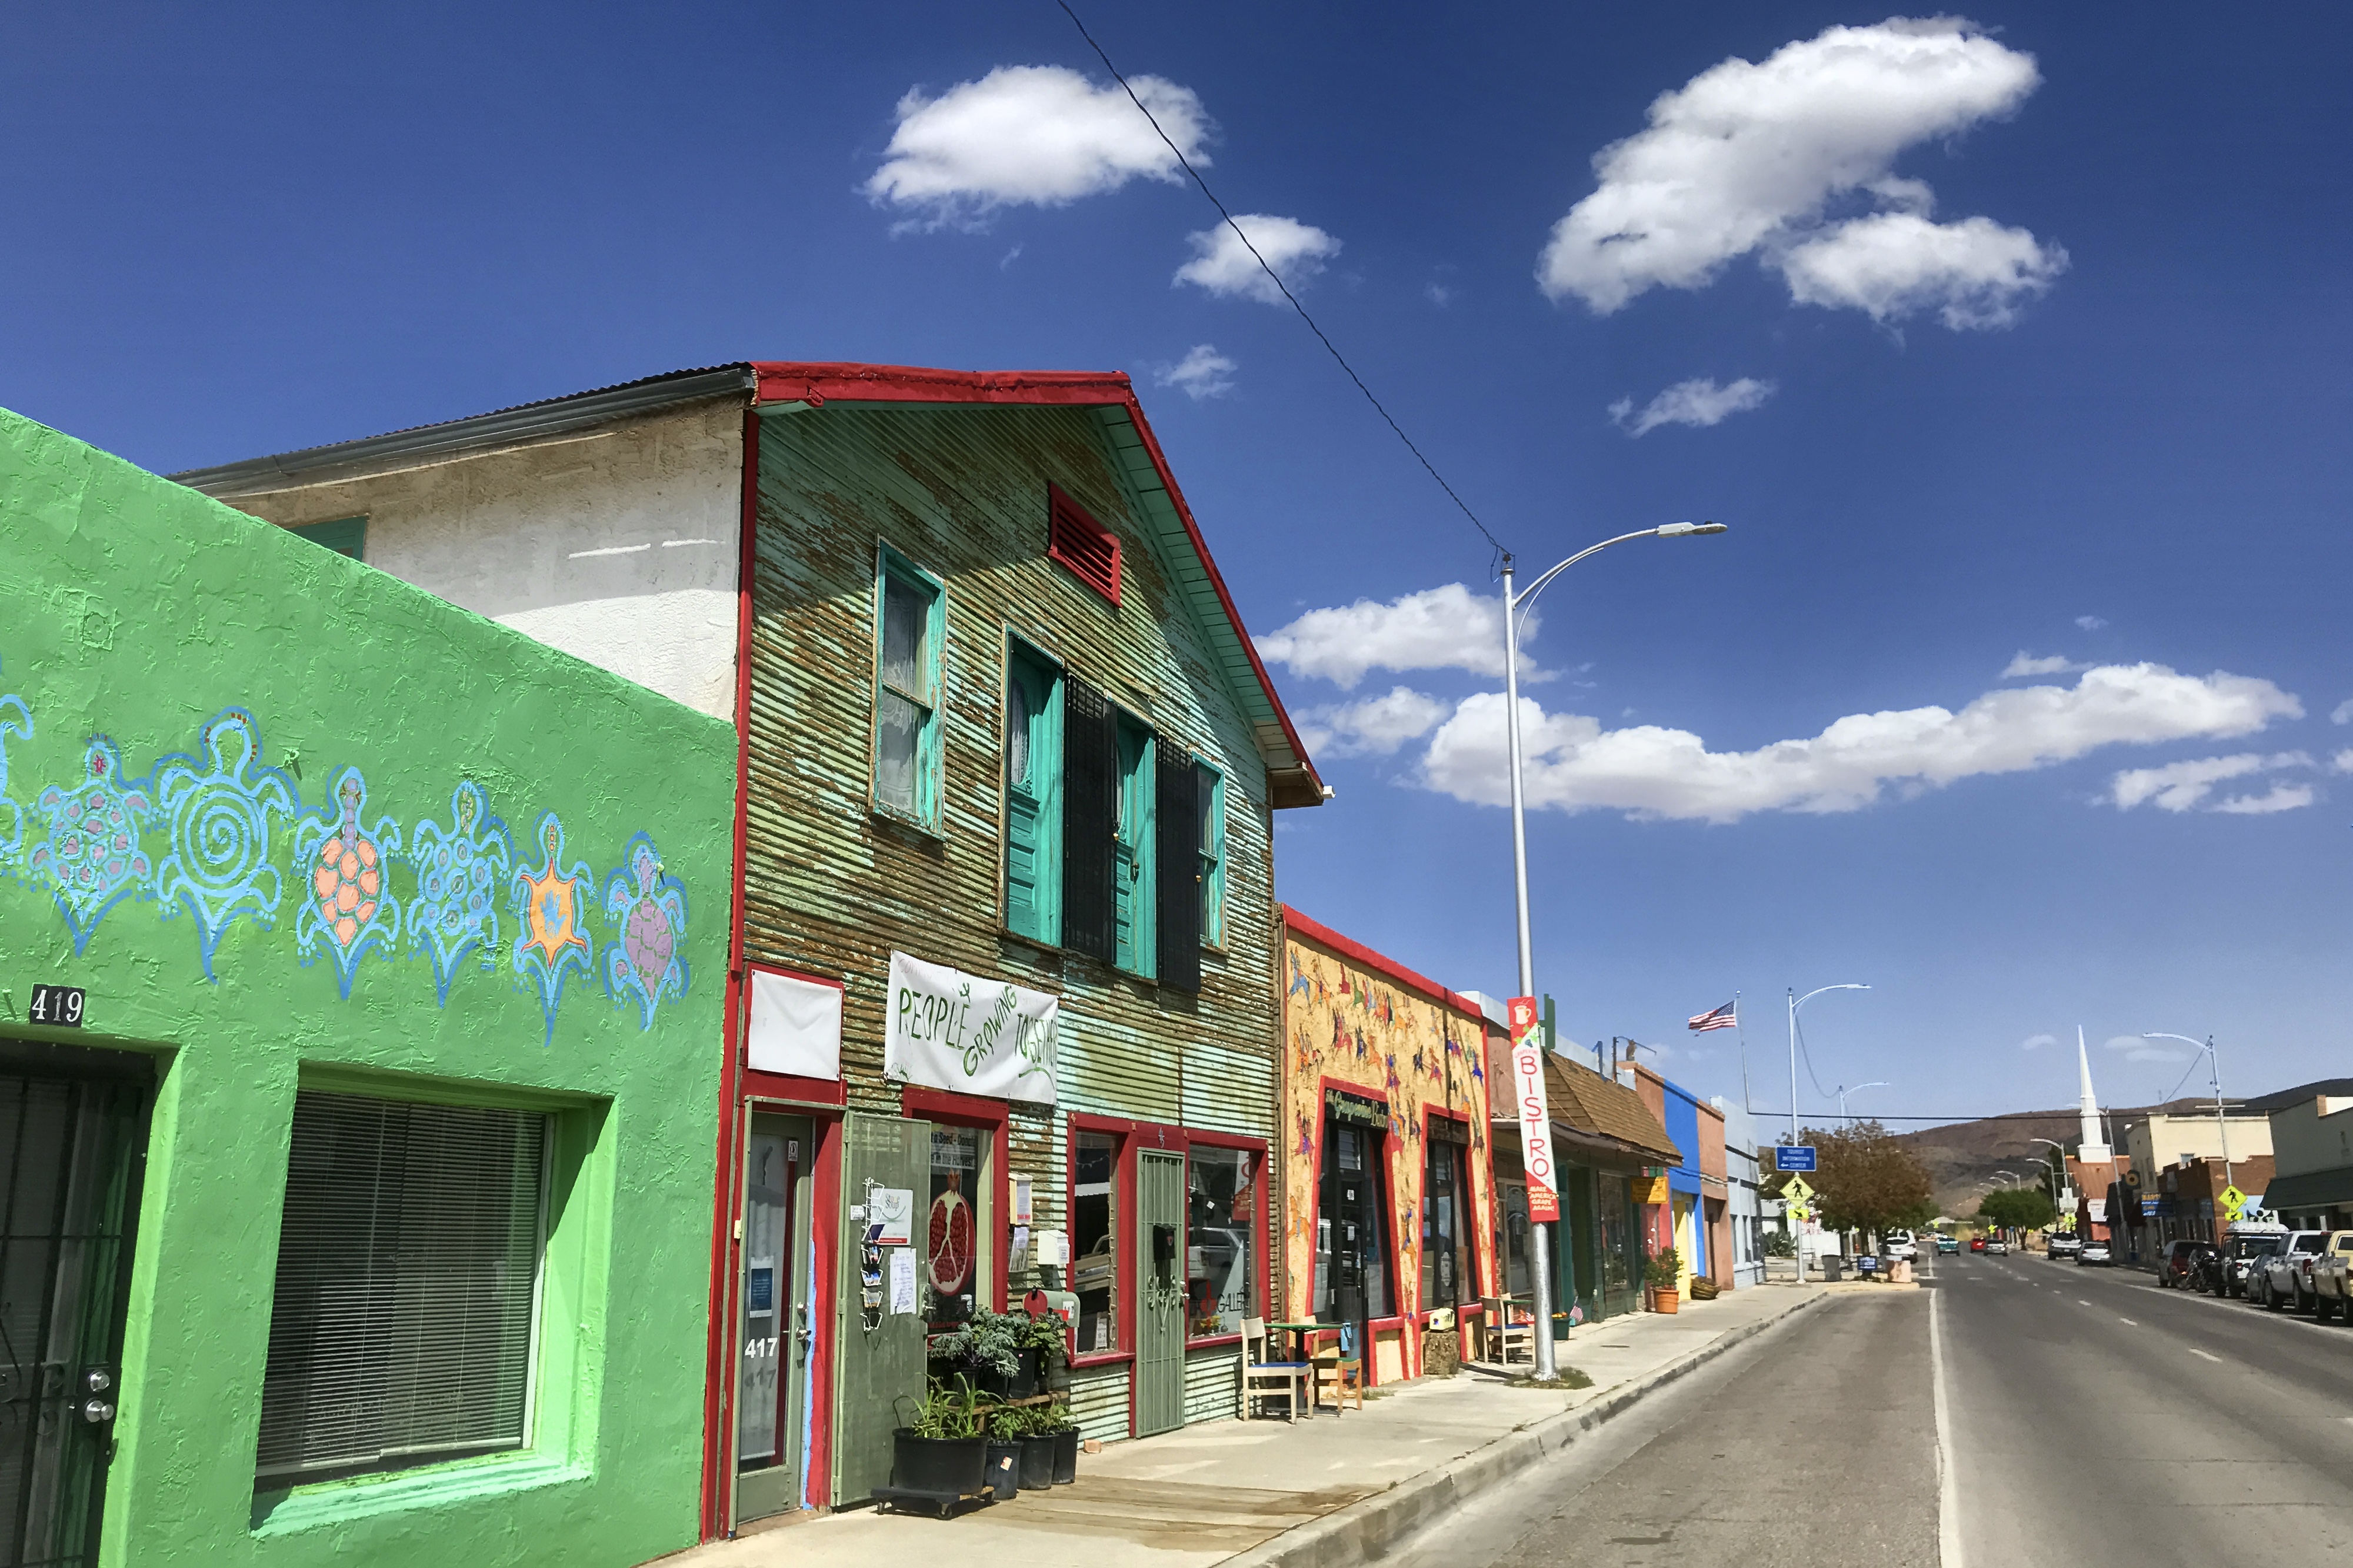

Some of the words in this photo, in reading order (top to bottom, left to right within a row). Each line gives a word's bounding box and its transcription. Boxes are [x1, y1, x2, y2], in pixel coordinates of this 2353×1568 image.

[32, 989, 82, 1022] 419
[899, 987, 971, 1050] PEOPLE
[963, 985, 1017, 1077] GROWING
[1014, 1012, 1058, 1067] TOGETHER
[1520, 1055, 1549, 1177] BISTRO
[885, 1199, 899, 1211] Soup
[745, 1337, 778, 1359] 417
